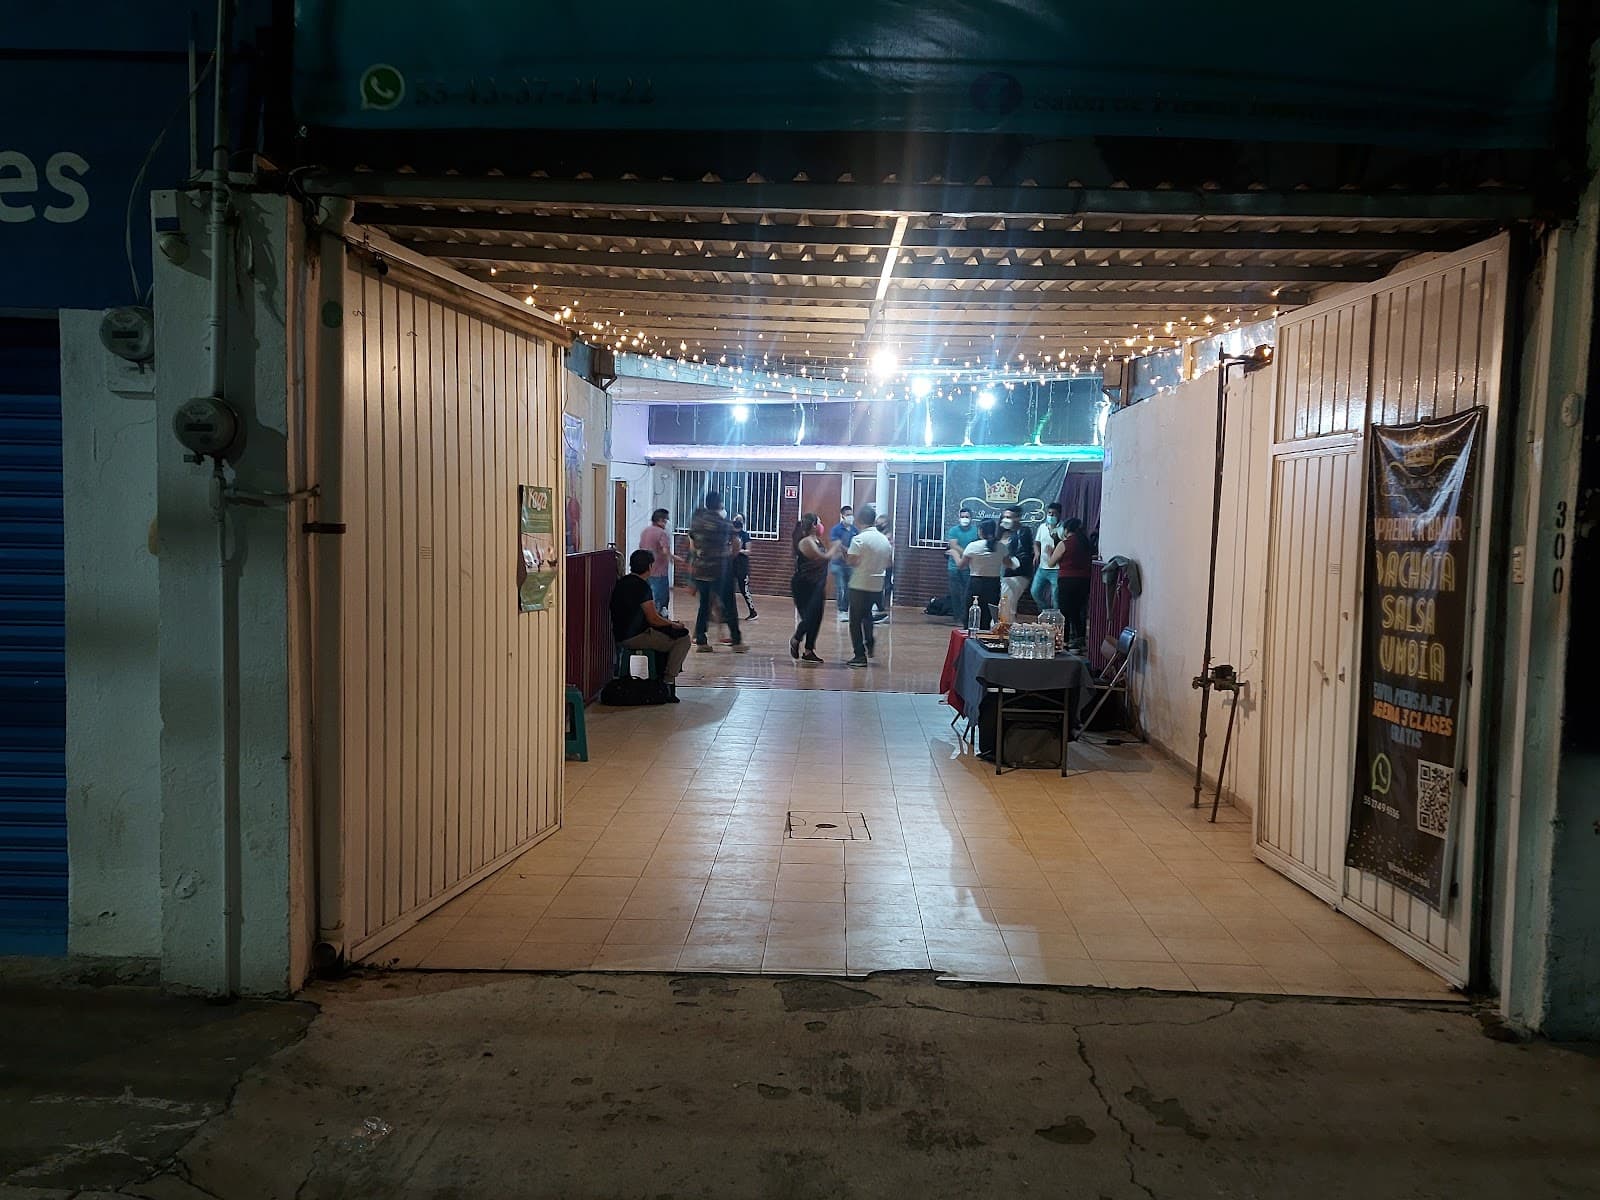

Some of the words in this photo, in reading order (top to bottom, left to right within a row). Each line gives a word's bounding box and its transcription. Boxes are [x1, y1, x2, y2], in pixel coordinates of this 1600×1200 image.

[528, 488, 548, 512] Yoga
[1375, 518, 1415, 541] PRENDE
[1553, 501, 1567, 594] 300
[1382, 594, 1435, 635] SALSA
[1380, 634, 1445, 682] UMBIA
[1444, 698, 1454, 716] Y
[1401, 710, 1409, 727] 3
[1410, 711, 1454, 736] CLASES
[1388, 724, 1423, 749] RATIS
